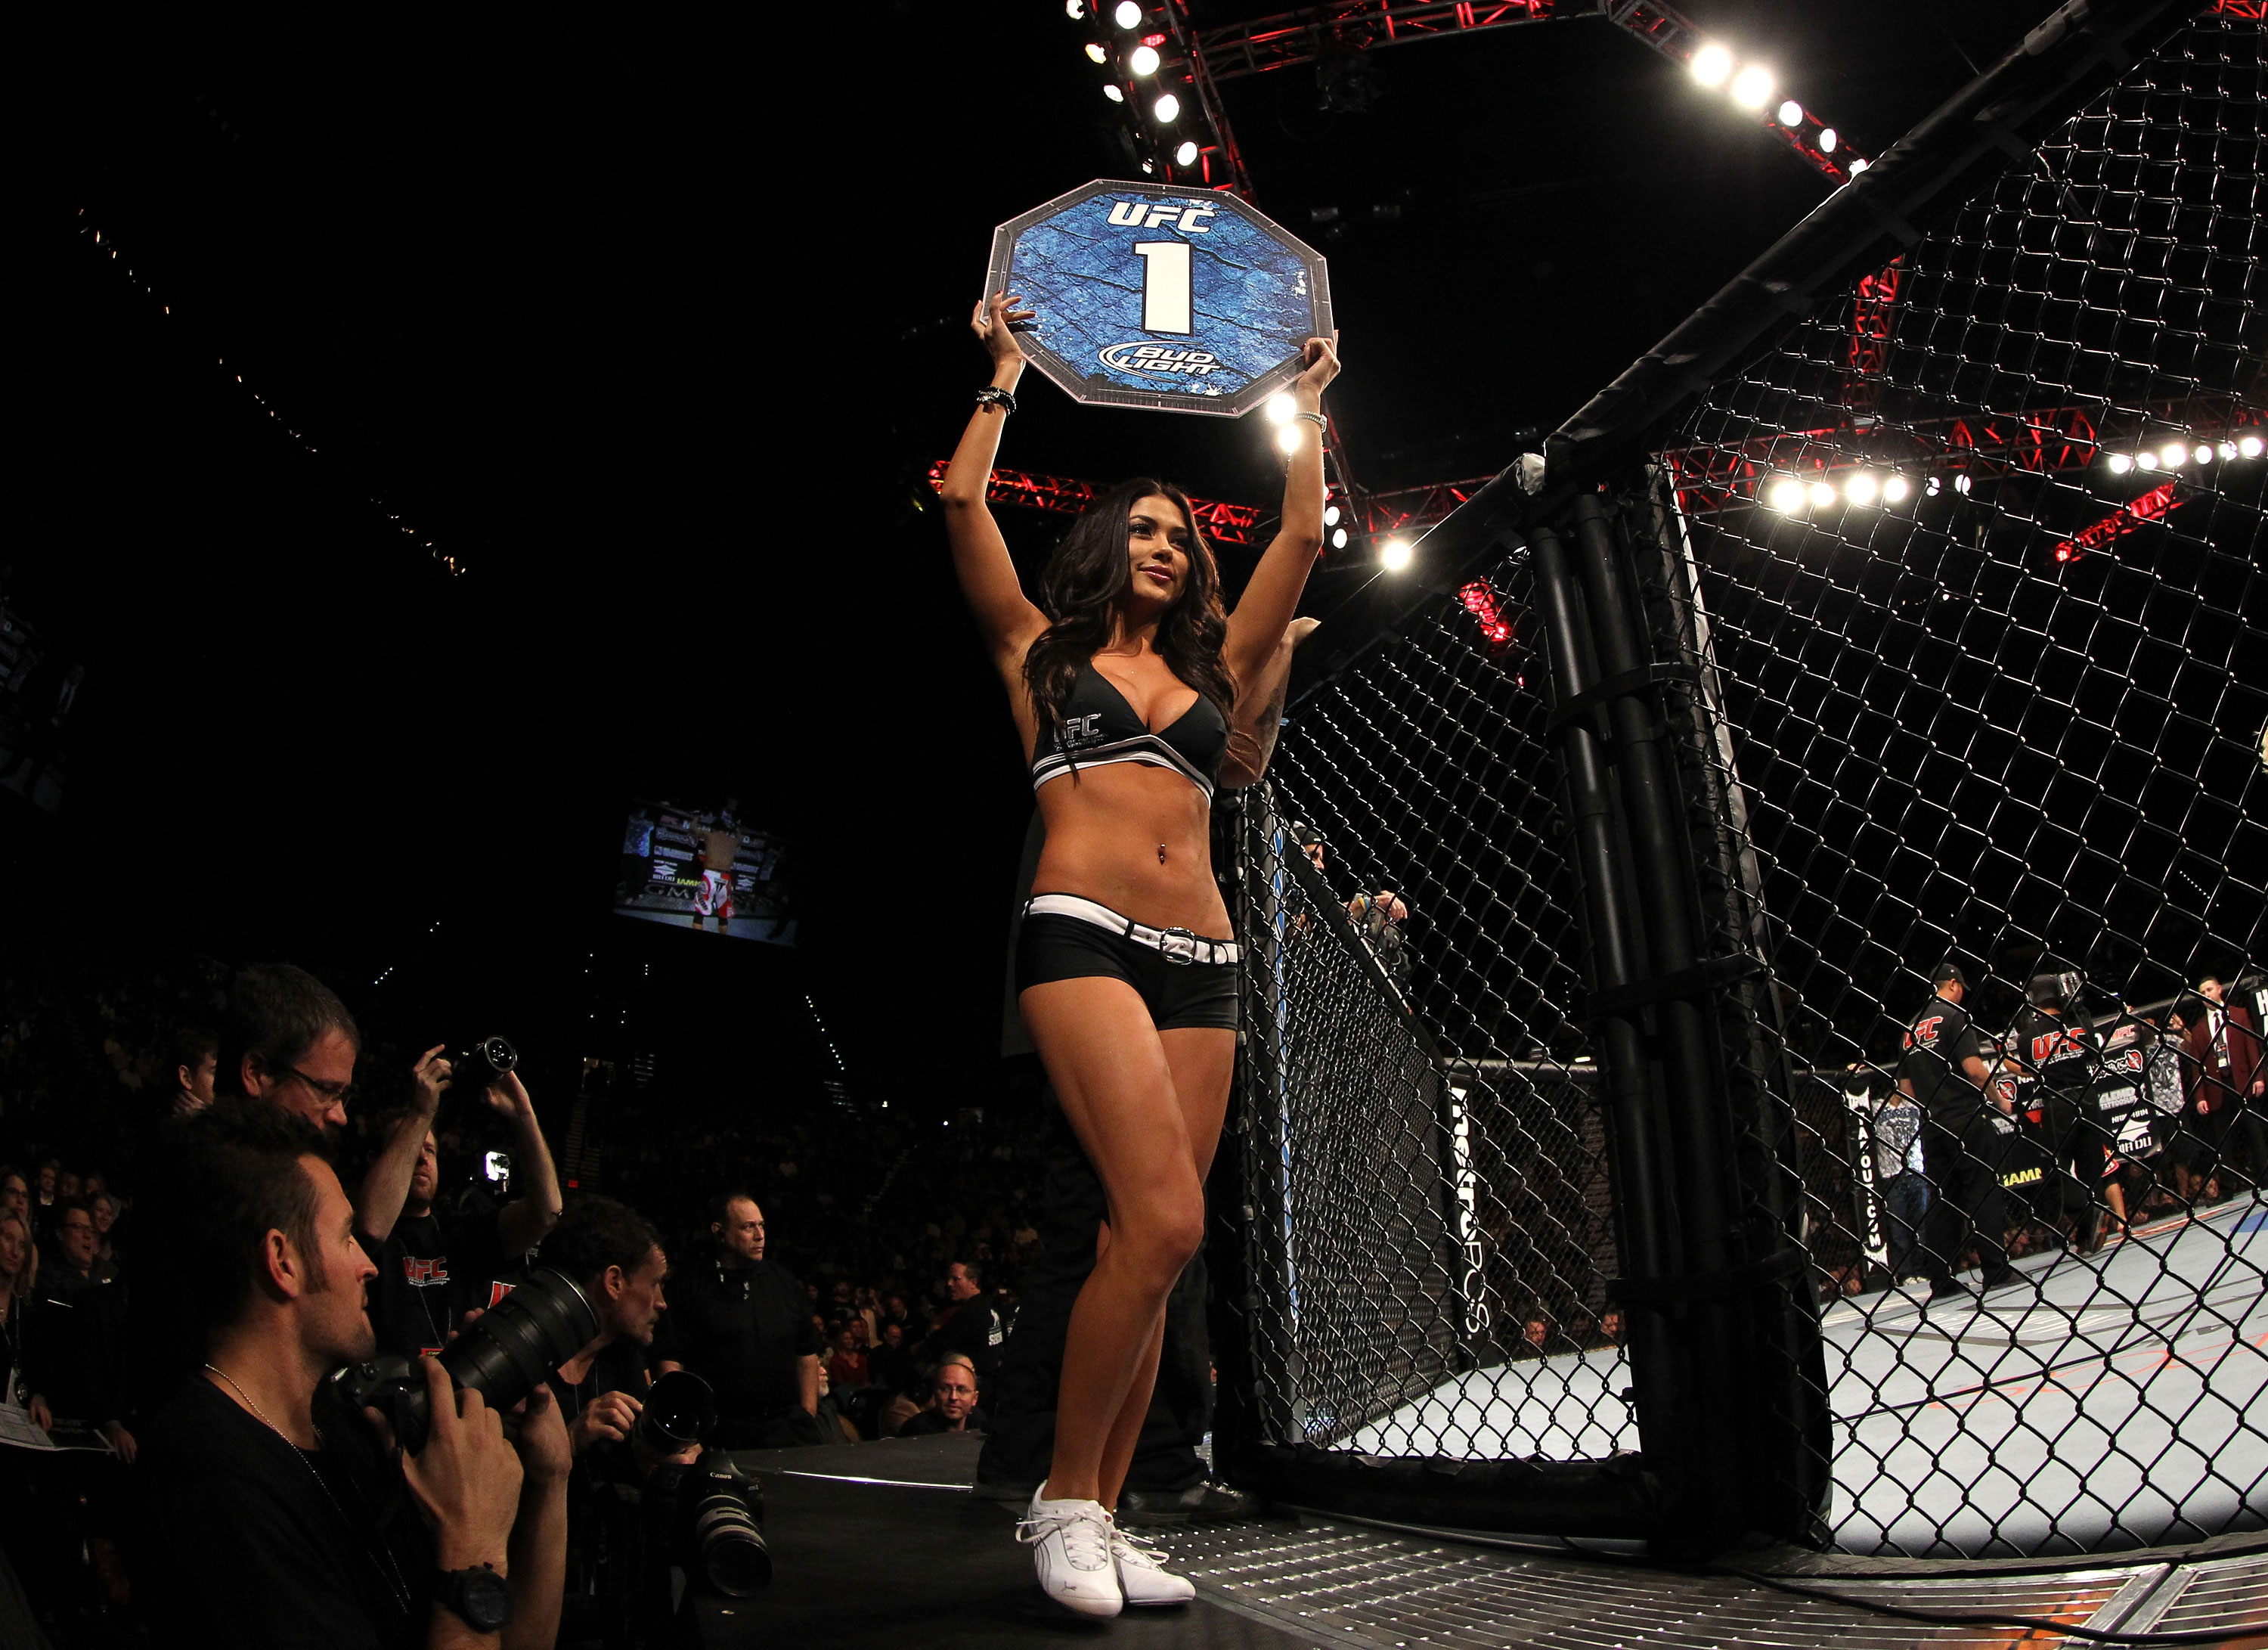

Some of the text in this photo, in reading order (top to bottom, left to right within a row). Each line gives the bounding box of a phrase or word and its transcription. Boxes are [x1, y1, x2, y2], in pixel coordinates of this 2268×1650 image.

[1107, 201, 1216, 233] UFC
[1134, 241, 1191, 335] 1
[1114, 355, 1221, 376] LIGHT
[1134, 346, 1215, 364] BUD
[1903, 1016, 1944, 1051] UFC
[2032, 1027, 2086, 1062] UFC
[2111, 1024, 2135, 1042] UFC
[403, 1256, 448, 1281] UFC
[709, 1472, 732, 1480] Canon
